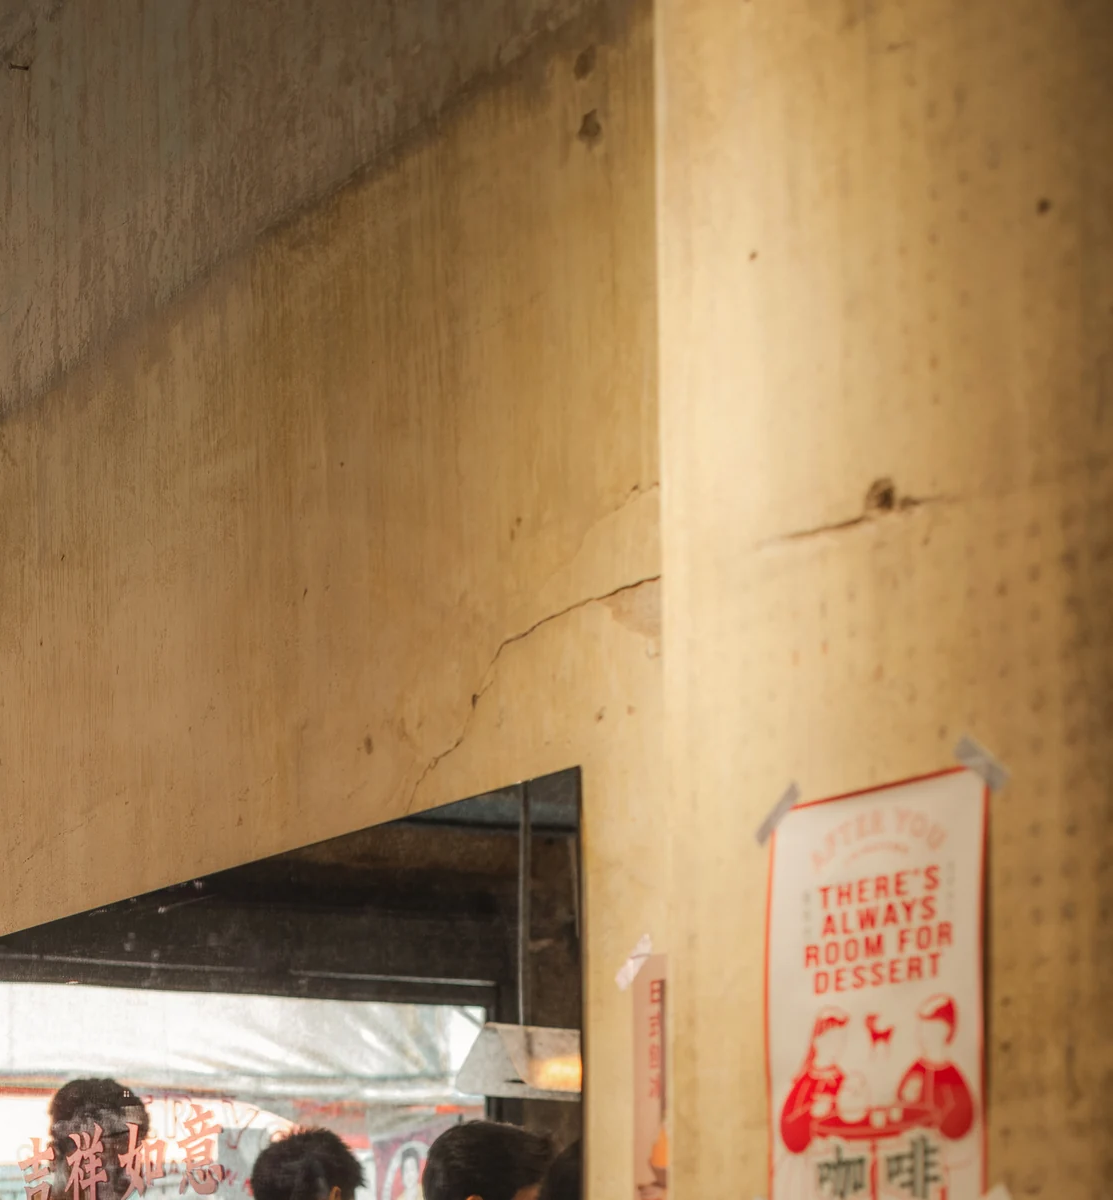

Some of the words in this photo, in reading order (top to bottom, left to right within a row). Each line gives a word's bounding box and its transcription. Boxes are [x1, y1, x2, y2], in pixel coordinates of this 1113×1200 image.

[819, 864, 940, 910] THERE'S
[821, 895, 936, 938] ALWAYS
[804, 933, 884, 969] ROOM
[898, 920, 953, 953] FOR
[813, 952, 941, 996] DESSERT
[817, 1132, 944, 1200] 咖啡
